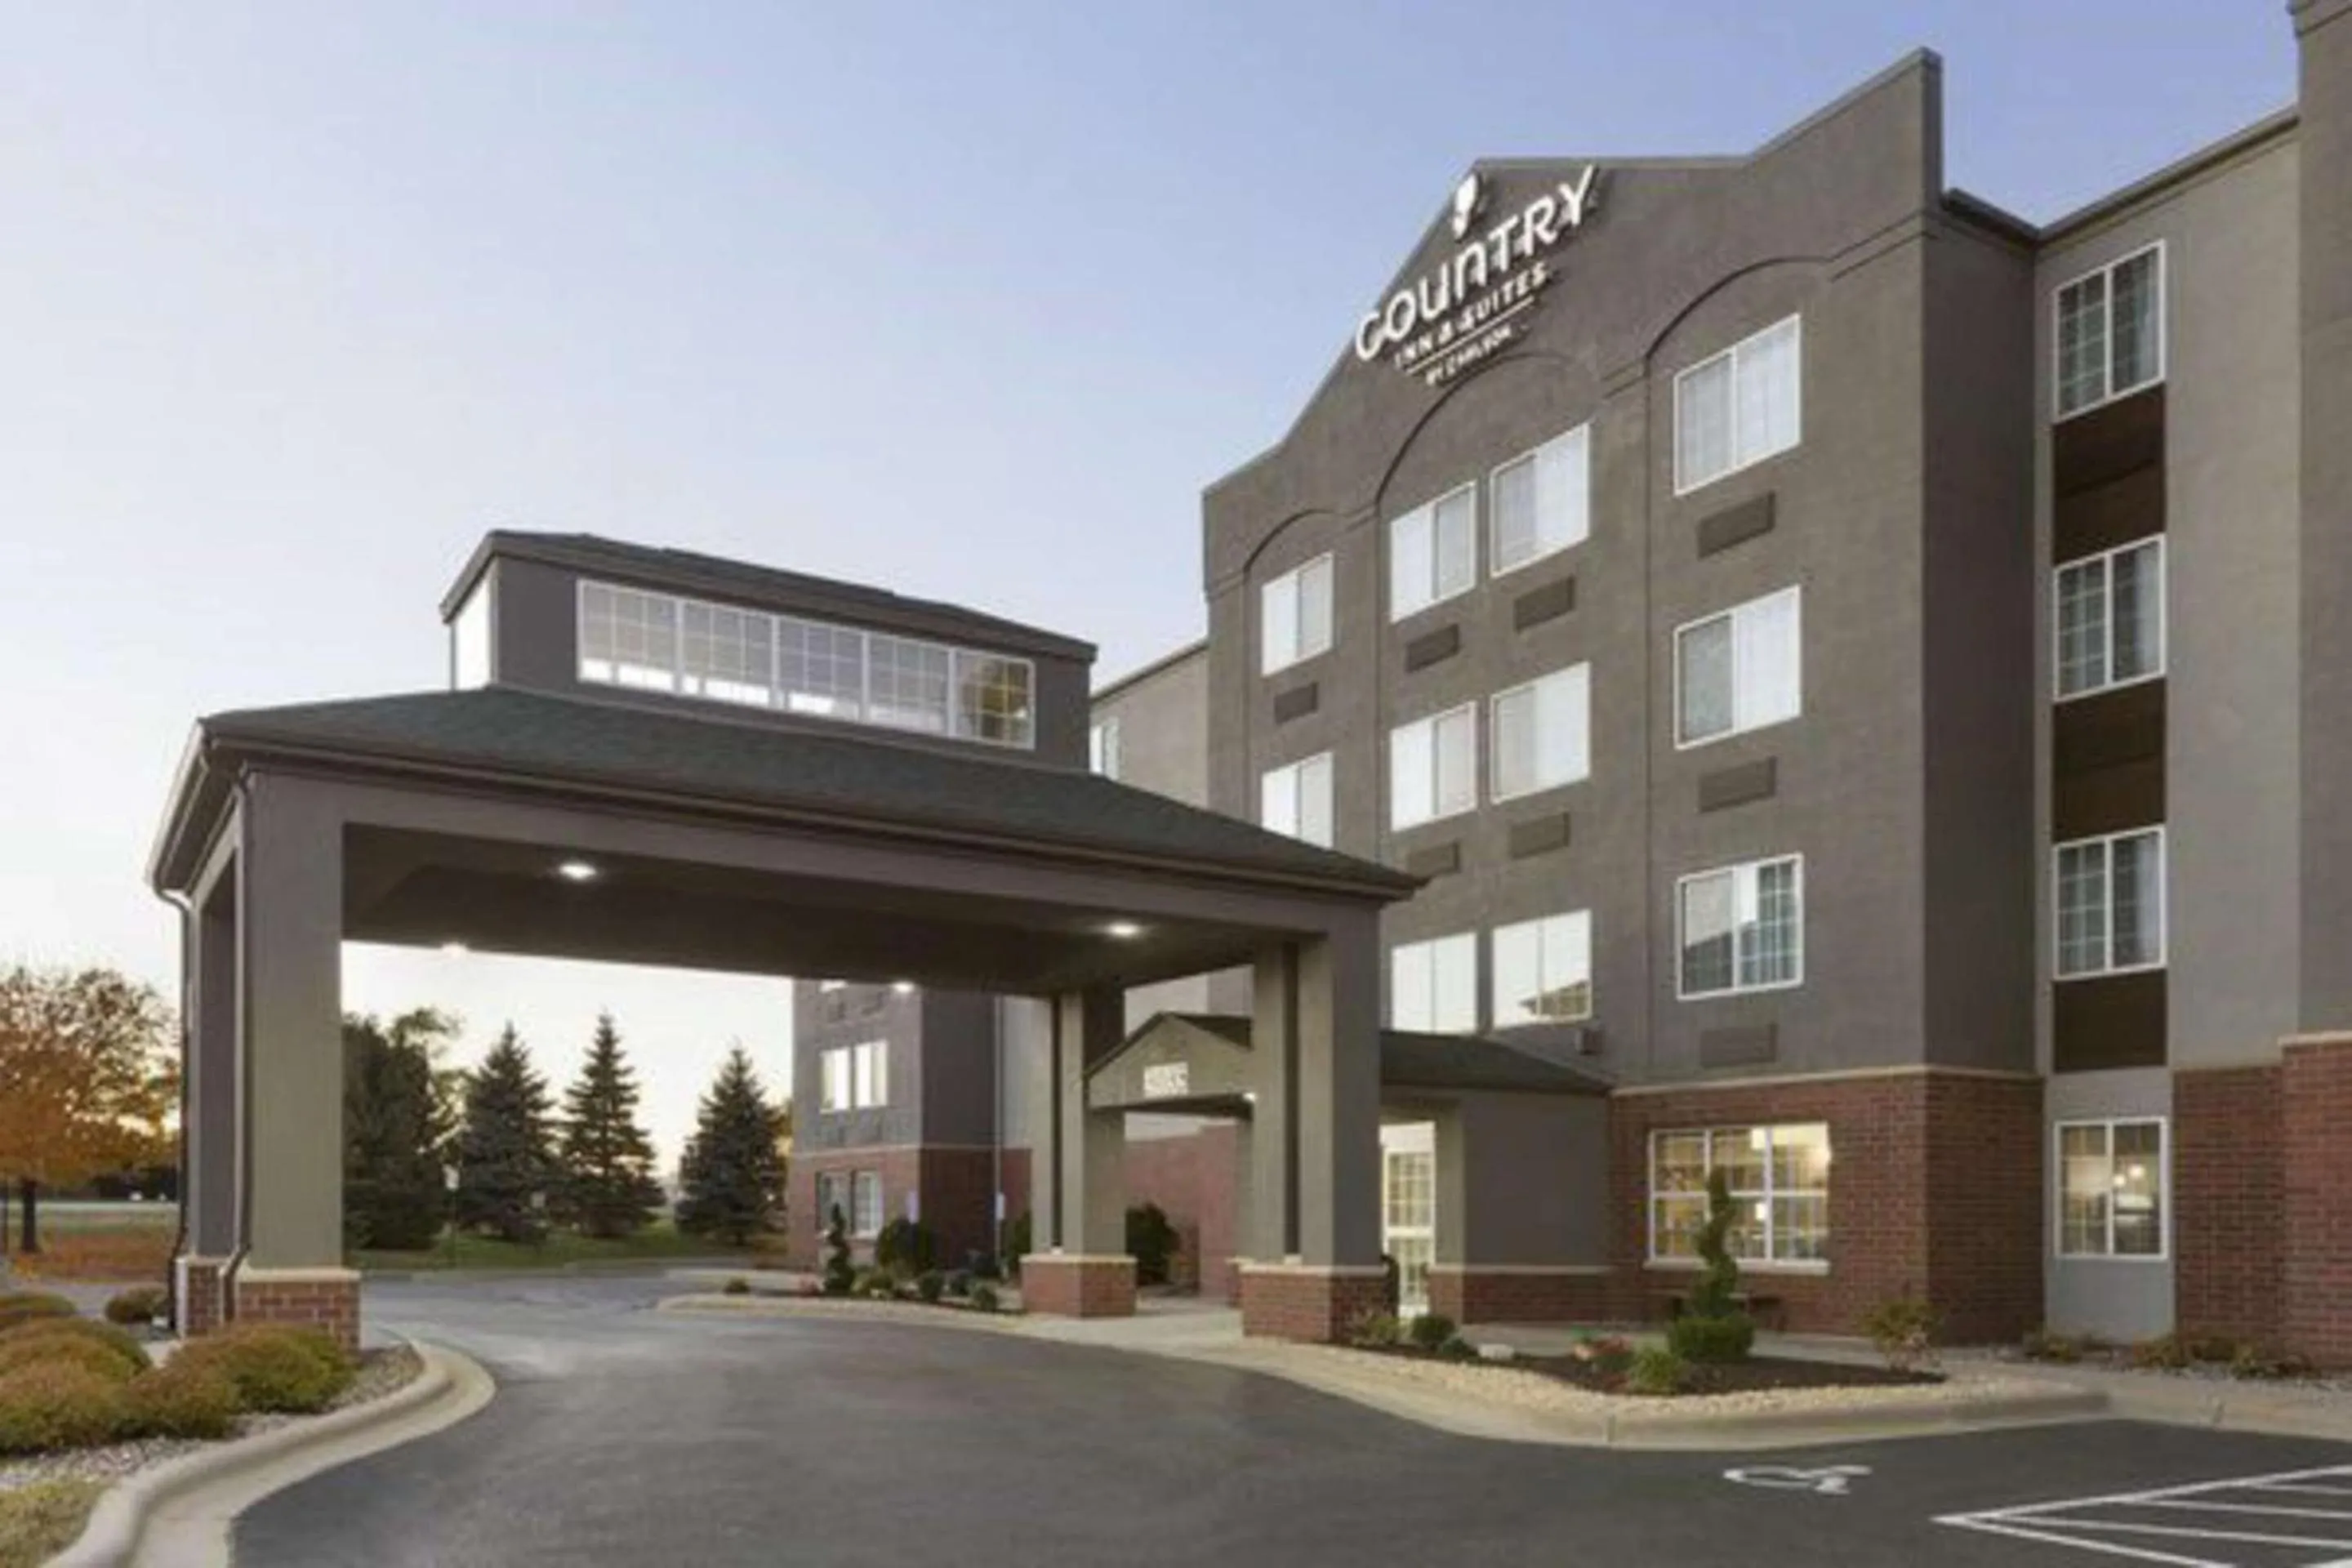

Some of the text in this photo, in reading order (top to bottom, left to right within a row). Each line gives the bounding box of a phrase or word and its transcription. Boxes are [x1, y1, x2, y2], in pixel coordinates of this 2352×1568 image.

[1356, 164, 1594, 361] COUNTRY
[1394, 332, 1433, 370] INN
[1457, 261, 1546, 332] SUITES
